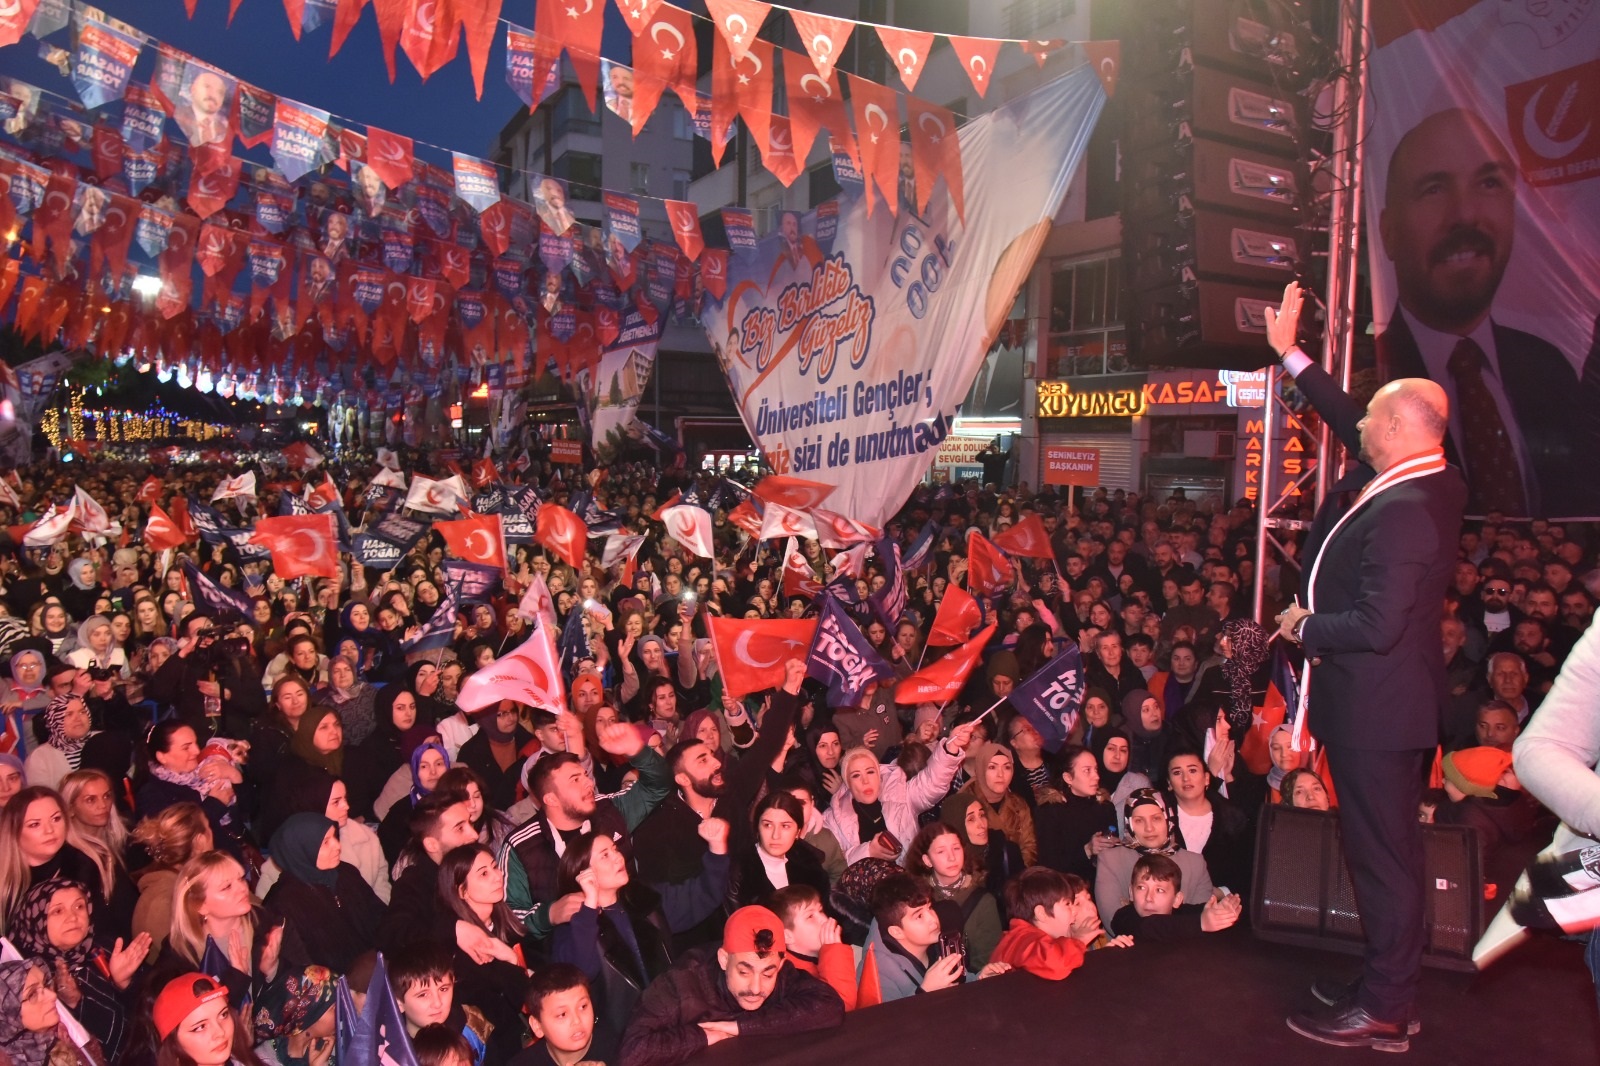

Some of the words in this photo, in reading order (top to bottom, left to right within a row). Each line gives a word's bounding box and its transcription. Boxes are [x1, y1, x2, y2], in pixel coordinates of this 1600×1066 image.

[742, 307, 776, 372] Biz
[779, 252, 852, 333] Birlikte
[798, 284, 874, 384] Güzeliz
[756, 384, 848, 436] Üniversiteli
[854, 370, 922, 420] Gençler
[1038, 392, 1143, 415] KUYUMCU
[793, 435, 822, 473] sizi
[828, 432, 849, 467] de
[939, 454, 976, 463] SEVGİLE
[1048, 450, 1096, 460] SENİNLEYİZ
[1245, 420, 1264, 503] MARKE
[518, 488, 537, 512] ASAN
[503, 523, 534, 533] TOGA
